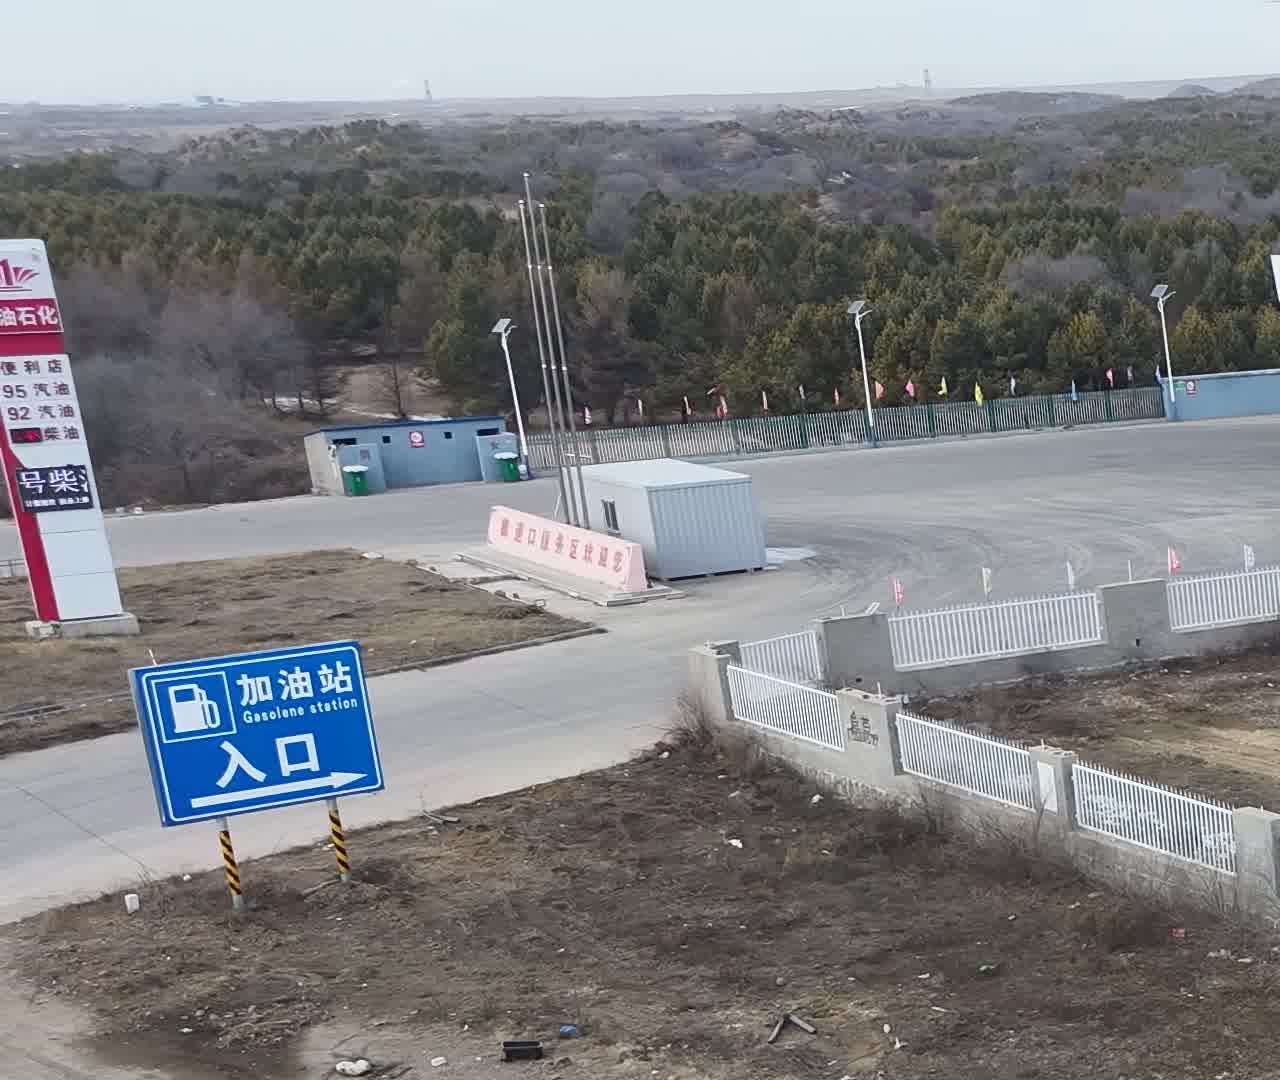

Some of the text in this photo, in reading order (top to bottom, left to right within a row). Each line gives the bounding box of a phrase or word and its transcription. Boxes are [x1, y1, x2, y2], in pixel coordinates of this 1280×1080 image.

[2, 382, 70, 398] 95 汽油
[8, 404, 75, 421] 92 汽油
[44, 425, 80, 441] 柴油
[236, 661, 353, 706] 加油站
[243, 697, 358, 724] Gasolene station
[216, 733, 320, 788] 入口
